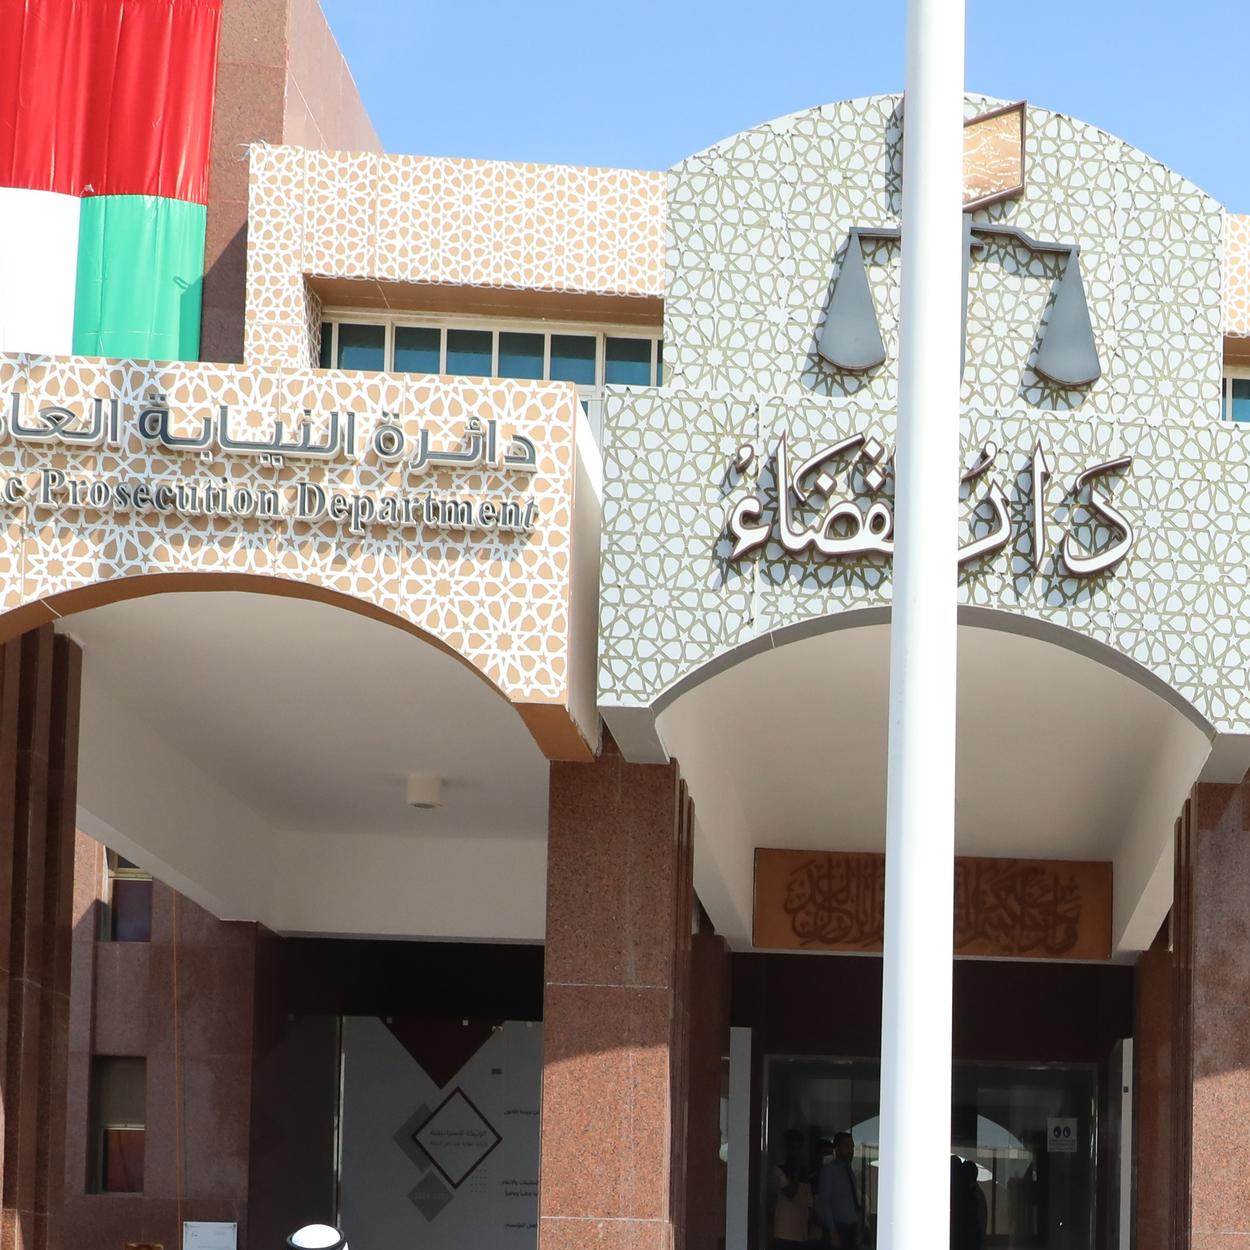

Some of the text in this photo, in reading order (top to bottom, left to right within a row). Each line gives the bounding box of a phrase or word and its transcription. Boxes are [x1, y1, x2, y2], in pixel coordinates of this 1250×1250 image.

[0, 391, 538, 475] دائرة النيابة العا
[38, 466, 286, 521] Prosecution
[293, 481, 540, 537] Department
[729, 430, 897, 560] قضاء
